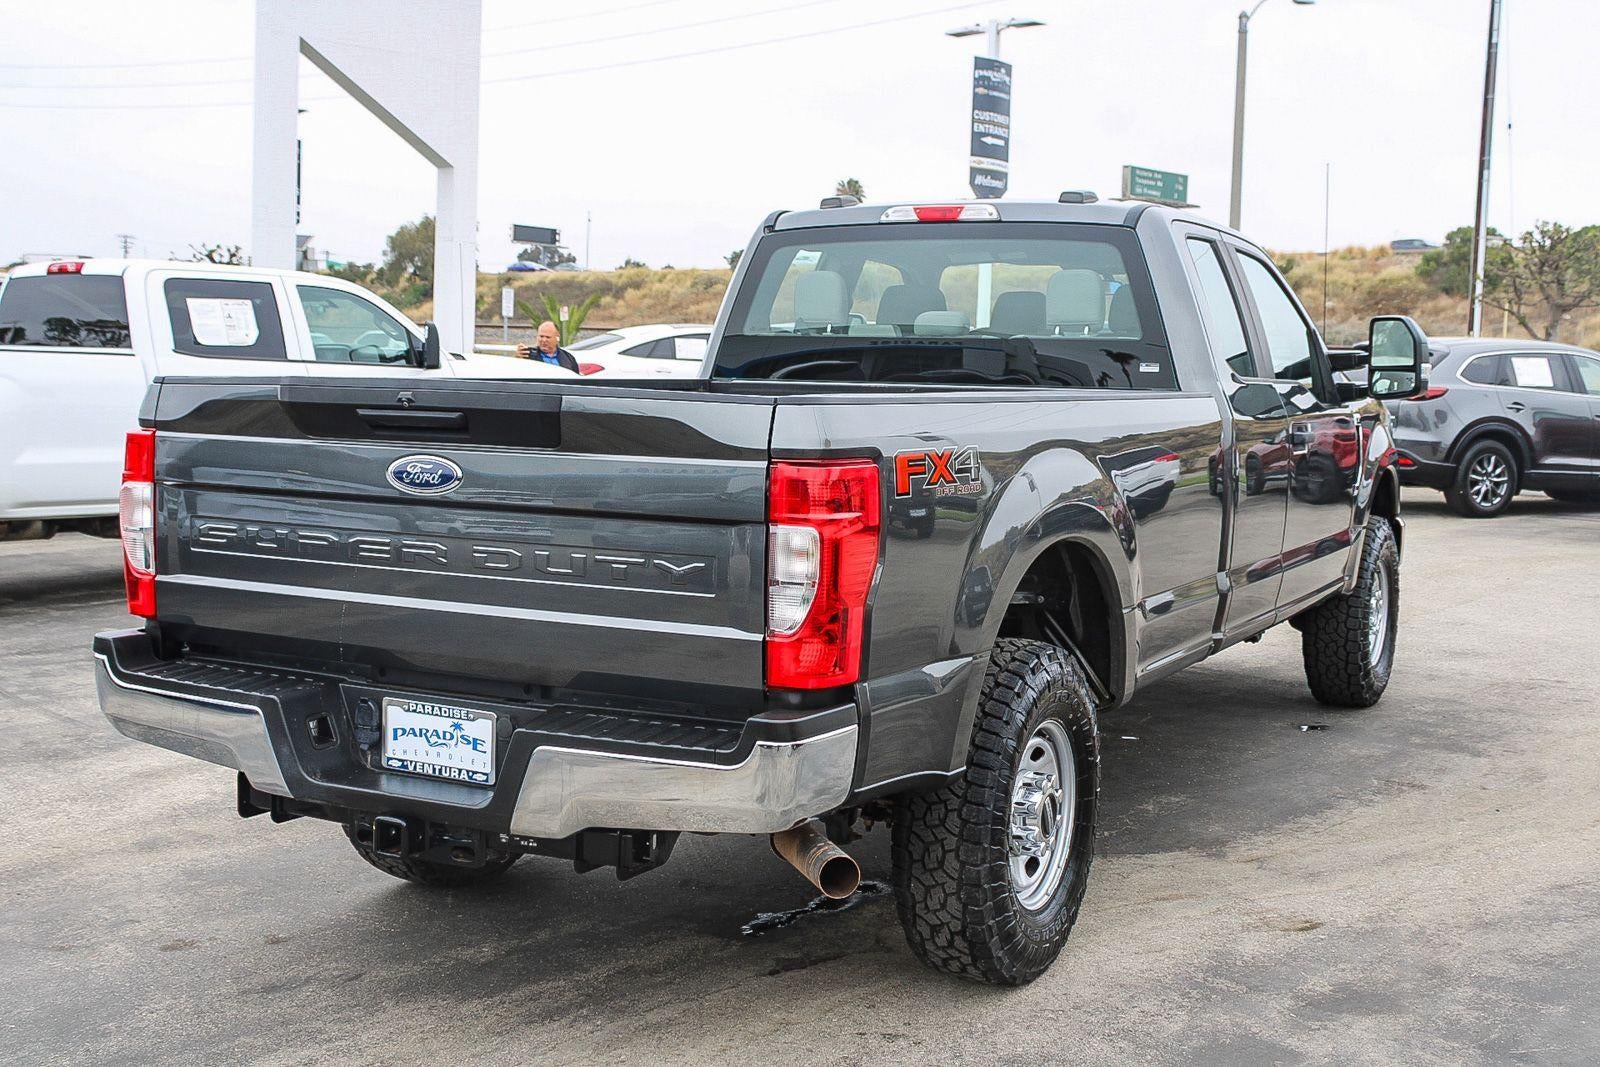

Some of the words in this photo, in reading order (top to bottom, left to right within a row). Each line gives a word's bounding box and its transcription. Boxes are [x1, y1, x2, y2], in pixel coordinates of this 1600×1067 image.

[973, 122, 1008, 138] ENTRANCE
[402, 462, 443, 485] Ford
[892, 445, 982, 499] FX4
[935, 486, 955, 497] OFF
[956, 483, 981, 495] ROAD
[197, 521, 448, 568] SUPER
[471, 544, 707, 586] DUTY
[408, 703, 469, 720] PARADISE
[392, 721, 487, 755] PARADISE
[391, 748, 487, 769] CHEVROLET
[406, 759, 469, 781] VENTURA
